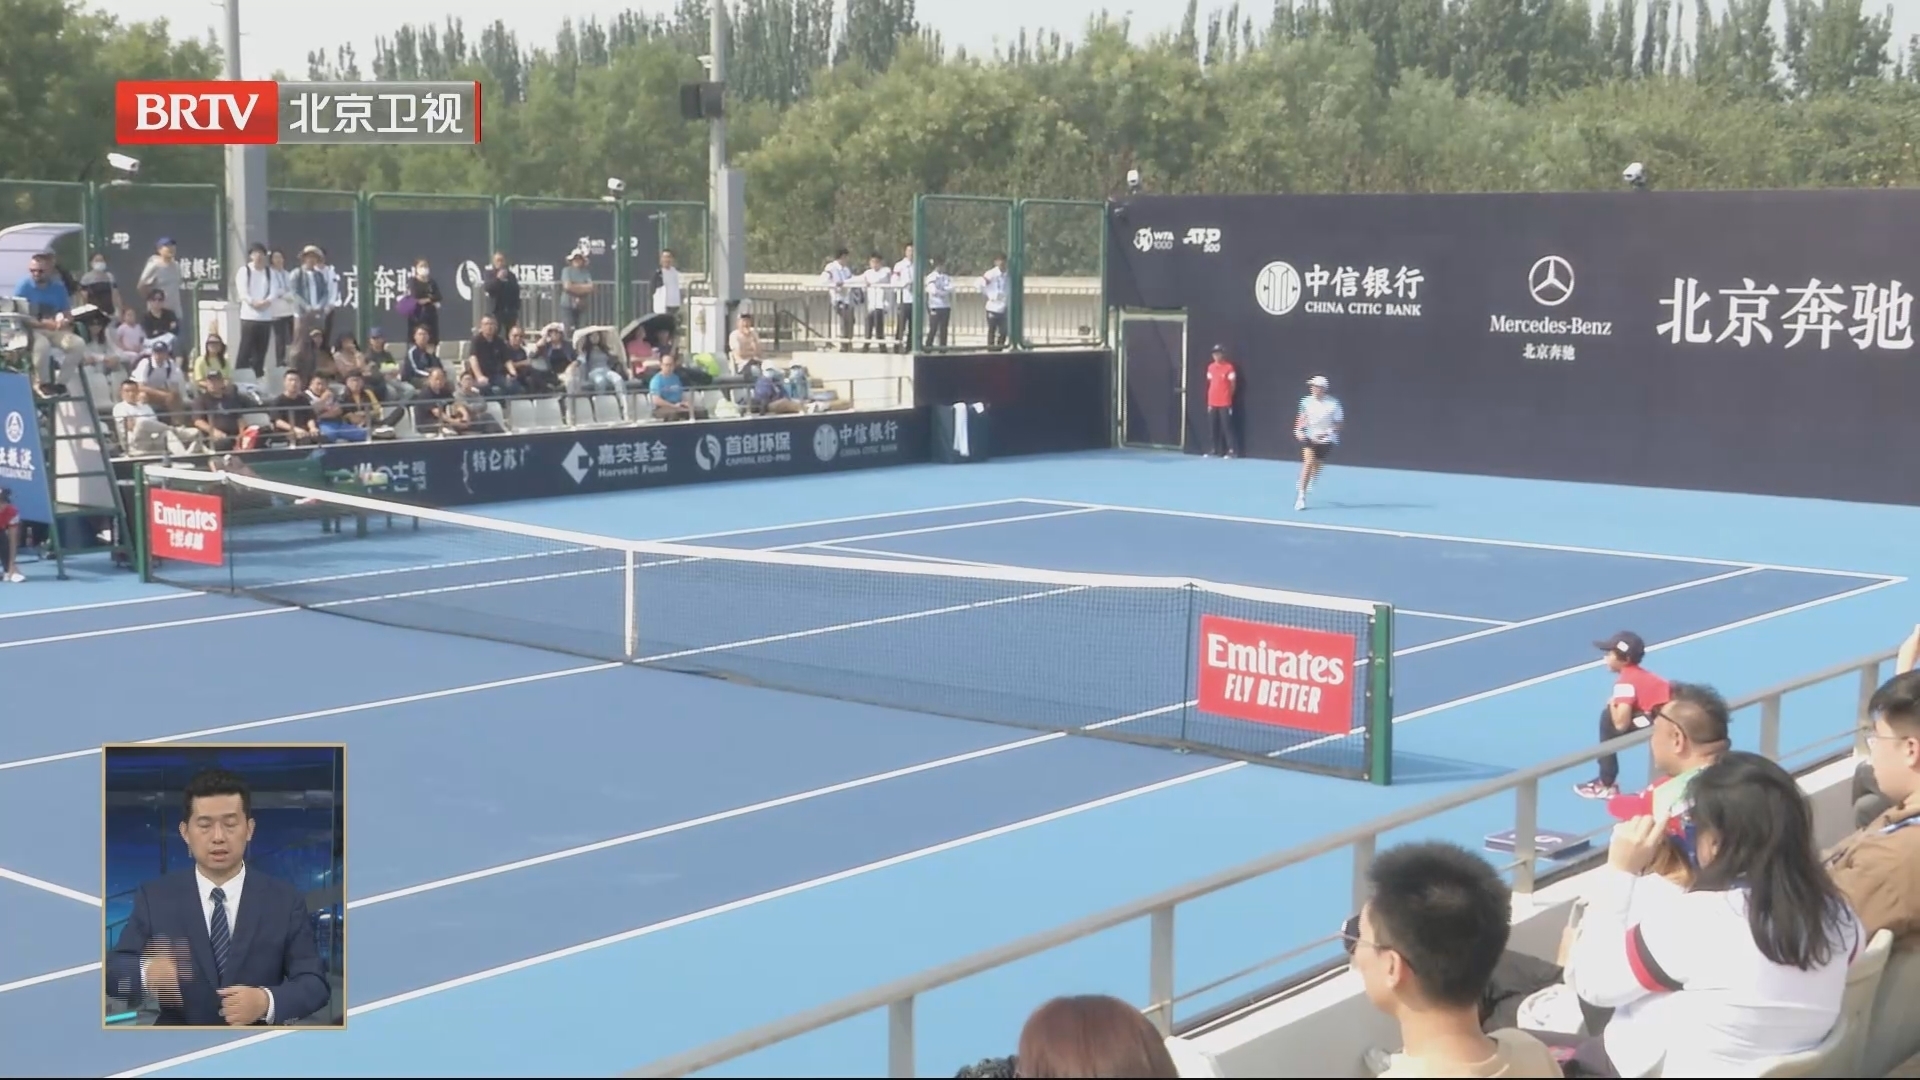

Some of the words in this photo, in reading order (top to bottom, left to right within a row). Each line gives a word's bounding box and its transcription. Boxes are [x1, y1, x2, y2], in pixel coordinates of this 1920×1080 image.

[1153, 231, 1174, 240] WTA
[1153, 241, 1173, 249] 1000
[1183, 227, 1221, 244] ATP
[1304, 264, 1424, 299] 中信银行
[1305, 301, 1344, 314] CHINA
[1348, 302, 1382, 315] CITIC
[1385, 303, 1421, 316] BANK
[1656, 277, 1914, 350] 北京奔驰
[1489, 314, 1612, 335] Mercedes-Benz
[1523, 343, 1575, 360] 北京奔驰
[725, 431, 791, 456] 首创环保
[839, 420, 899, 446] 中信银行
[598, 439, 668, 465] 嘉实基金
[598, 466, 638, 477] Harvest
[642, 463, 668, 474] Fund
[153, 500, 218, 532] Emirates
[1207, 632, 1344, 685] Emirates
[1224, 673, 1255, 703] FLY
[1256, 678, 1322, 714] BETTER
